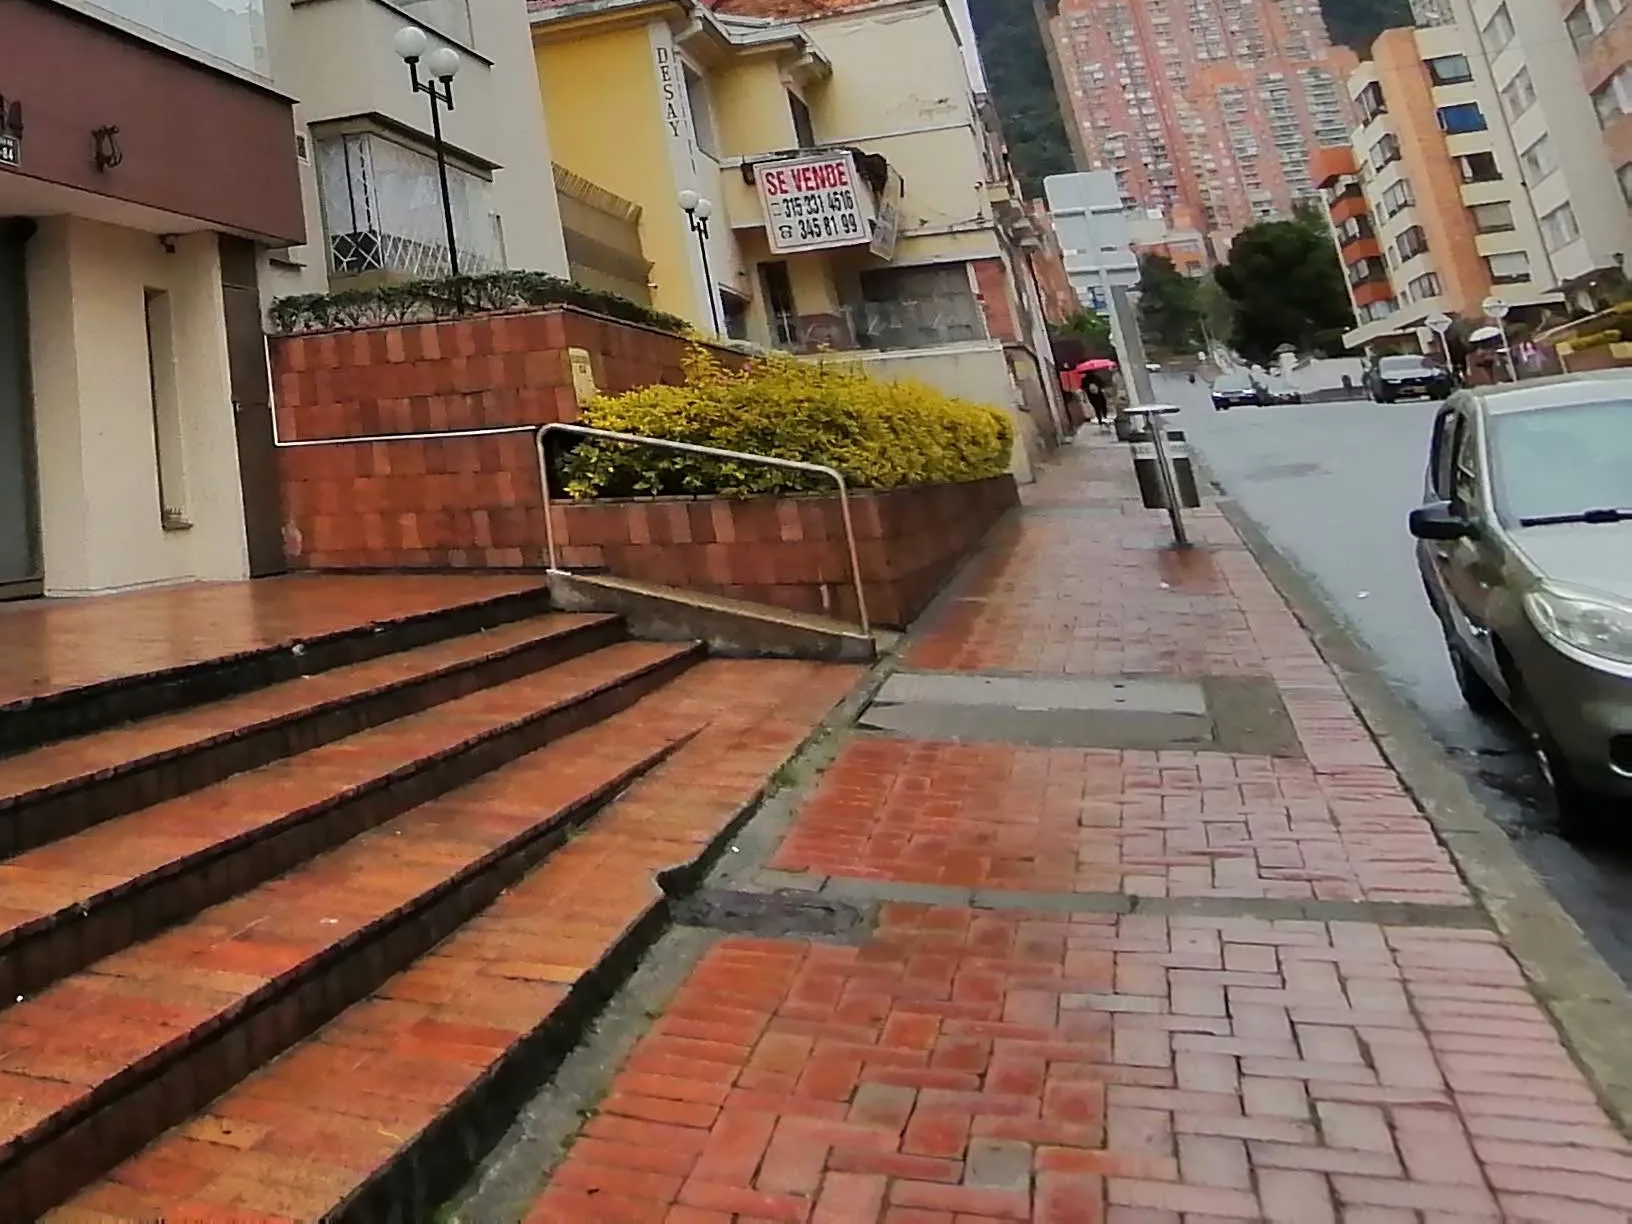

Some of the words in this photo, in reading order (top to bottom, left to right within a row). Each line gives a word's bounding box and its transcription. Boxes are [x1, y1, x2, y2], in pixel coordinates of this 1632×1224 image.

[657, 47, 679, 137] DESAY
[765, 171, 789, 196] SE
[791, 162, 849, 192] VENDE
[782, 197, 803, 218] 315
[828, 190, 854, 212] 4516
[798, 217, 822, 240] 345
[823, 215, 838, 237] 81
[841, 213, 858, 234] 99
